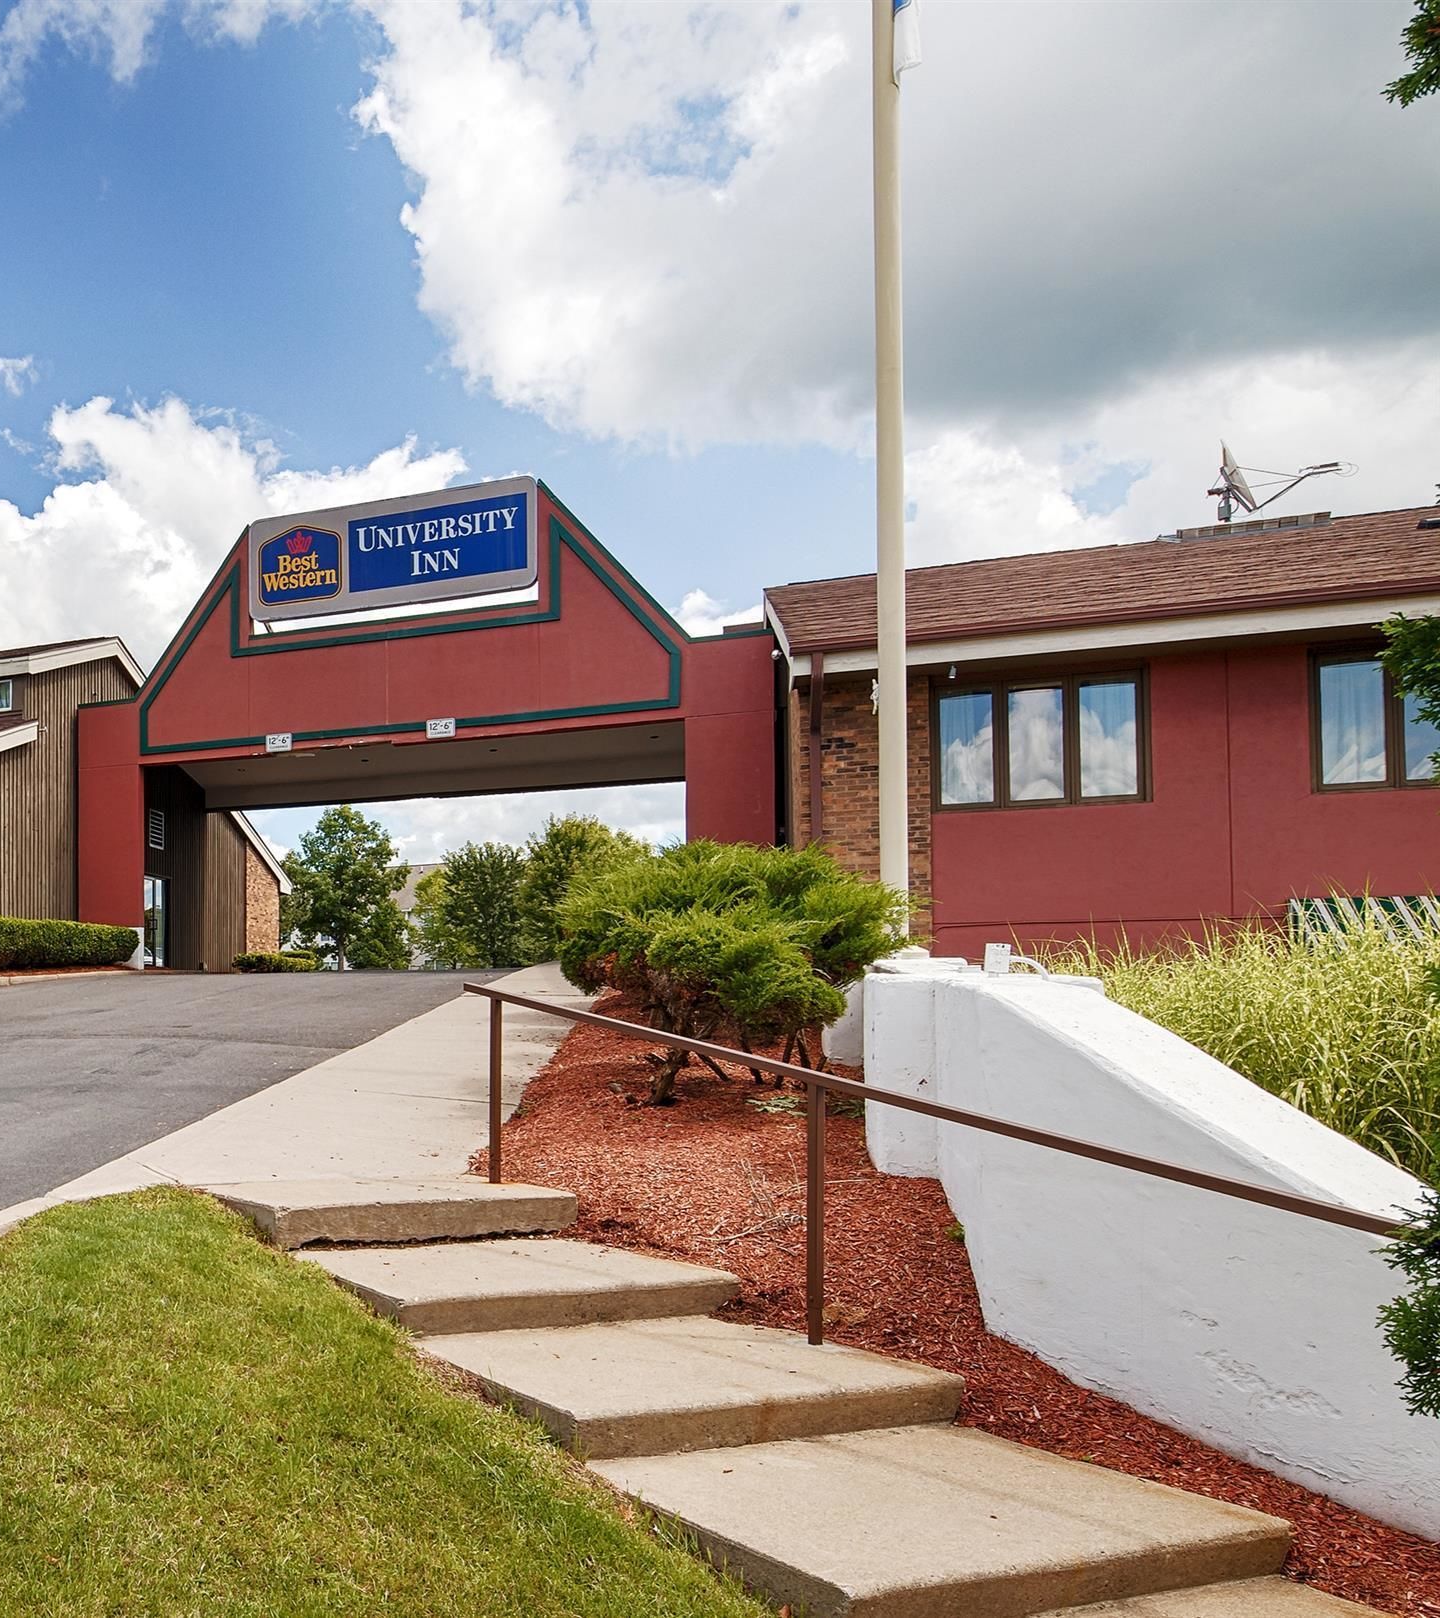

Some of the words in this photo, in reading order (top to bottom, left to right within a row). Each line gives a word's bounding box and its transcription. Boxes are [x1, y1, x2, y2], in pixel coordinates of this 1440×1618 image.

[356, 507, 518, 552] UNIVERSITY
[277, 551, 319, 574] Best
[410, 548, 461, 577] INN
[262, 566, 338, 593] Western
